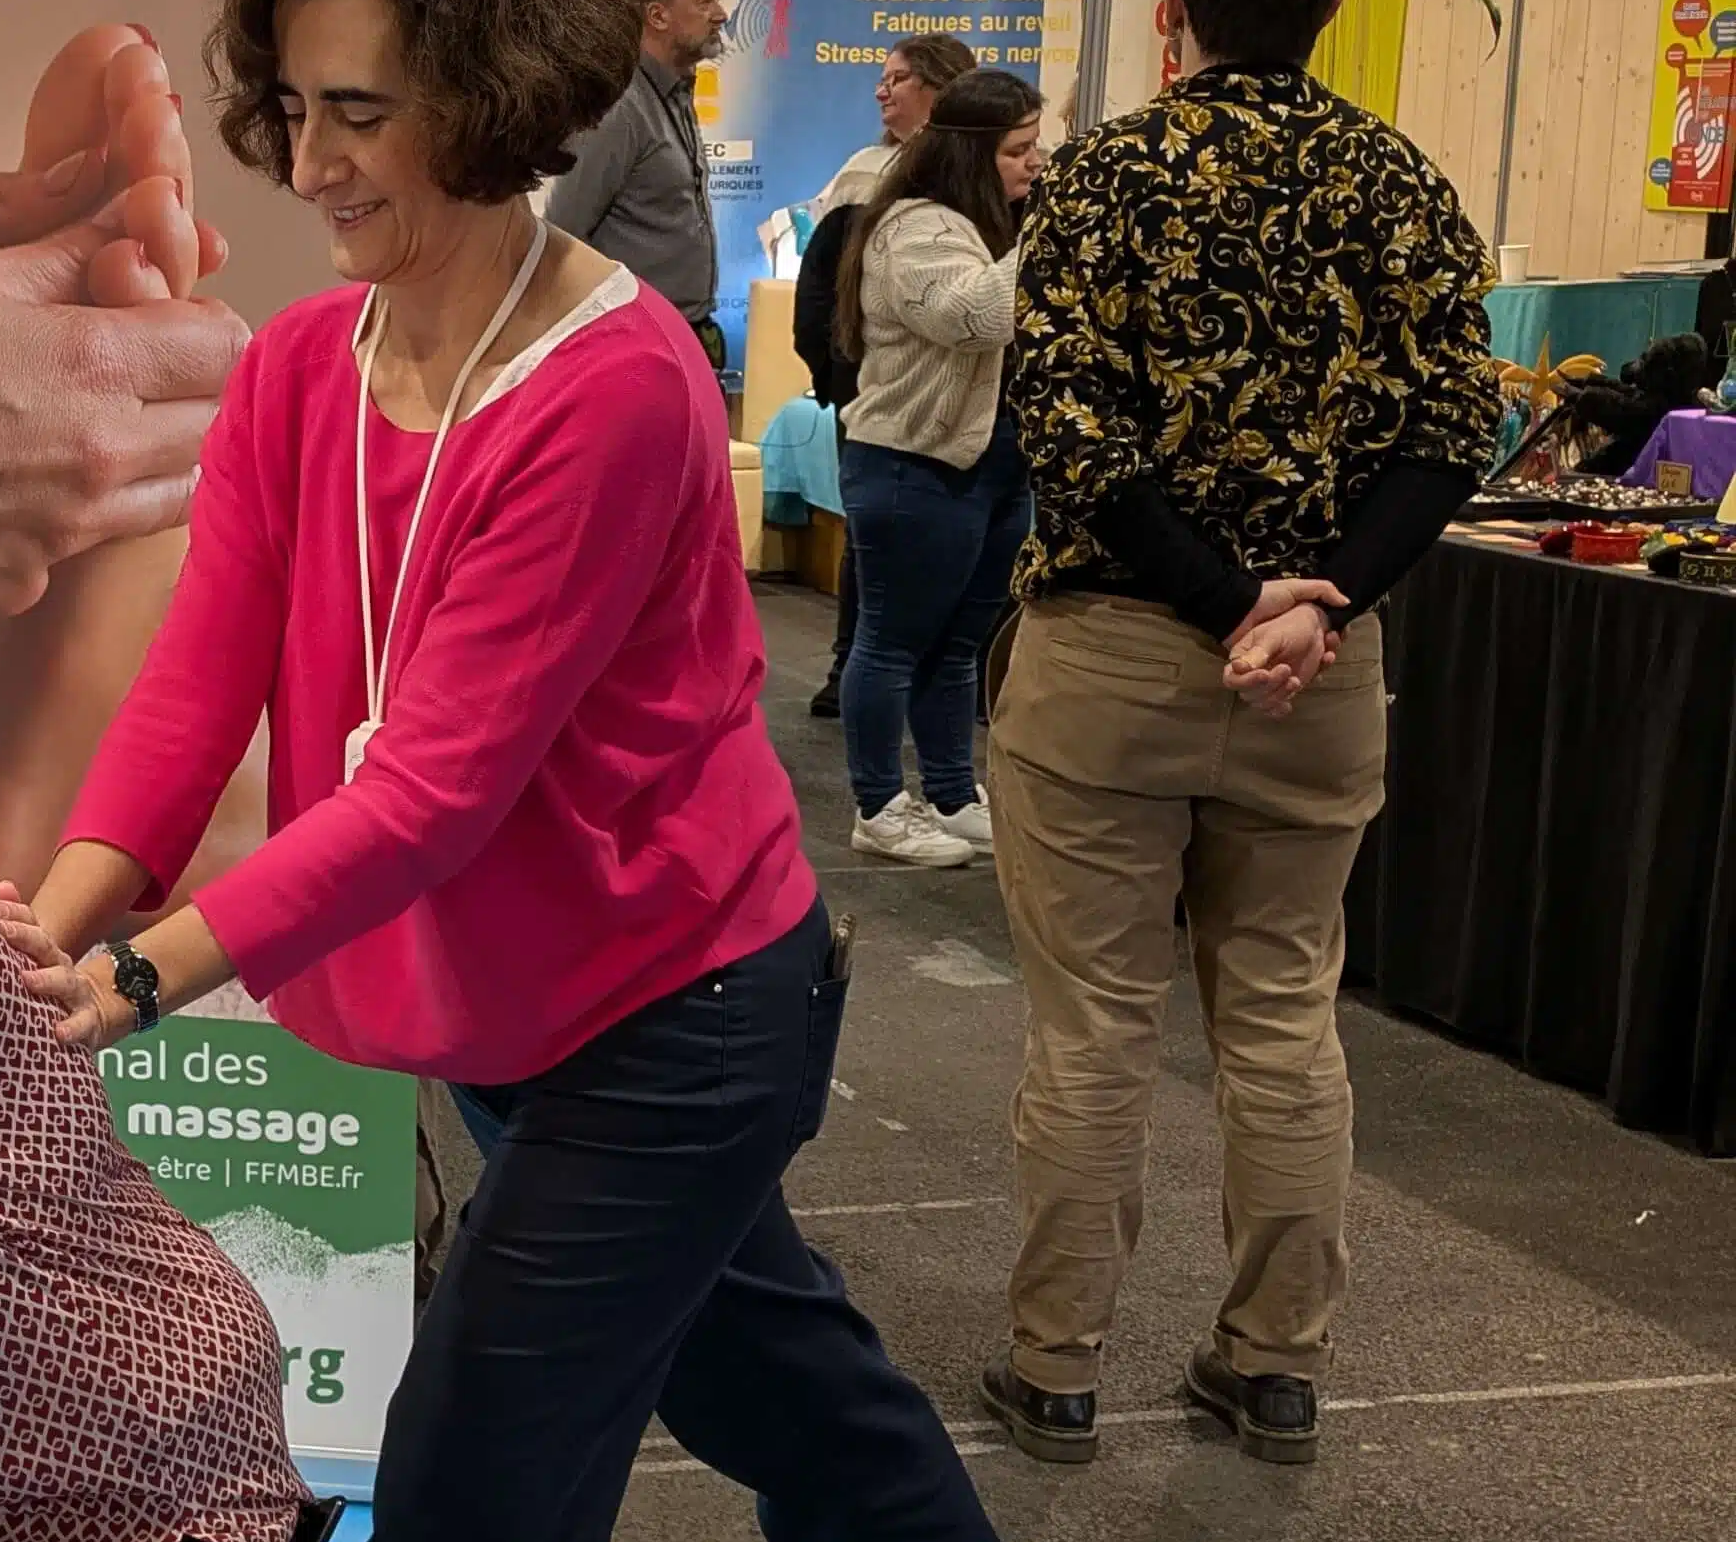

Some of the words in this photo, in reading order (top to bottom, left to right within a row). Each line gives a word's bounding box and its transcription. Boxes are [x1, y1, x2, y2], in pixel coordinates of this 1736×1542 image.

[872, 11, 972, 35] Fatigues
[980, 15, 1008, 31] au
[183, 1042, 268, 1086] des
[128, 1102, 360, 1155] massage
[246, 1161, 364, 1189] FFMBE.fr
